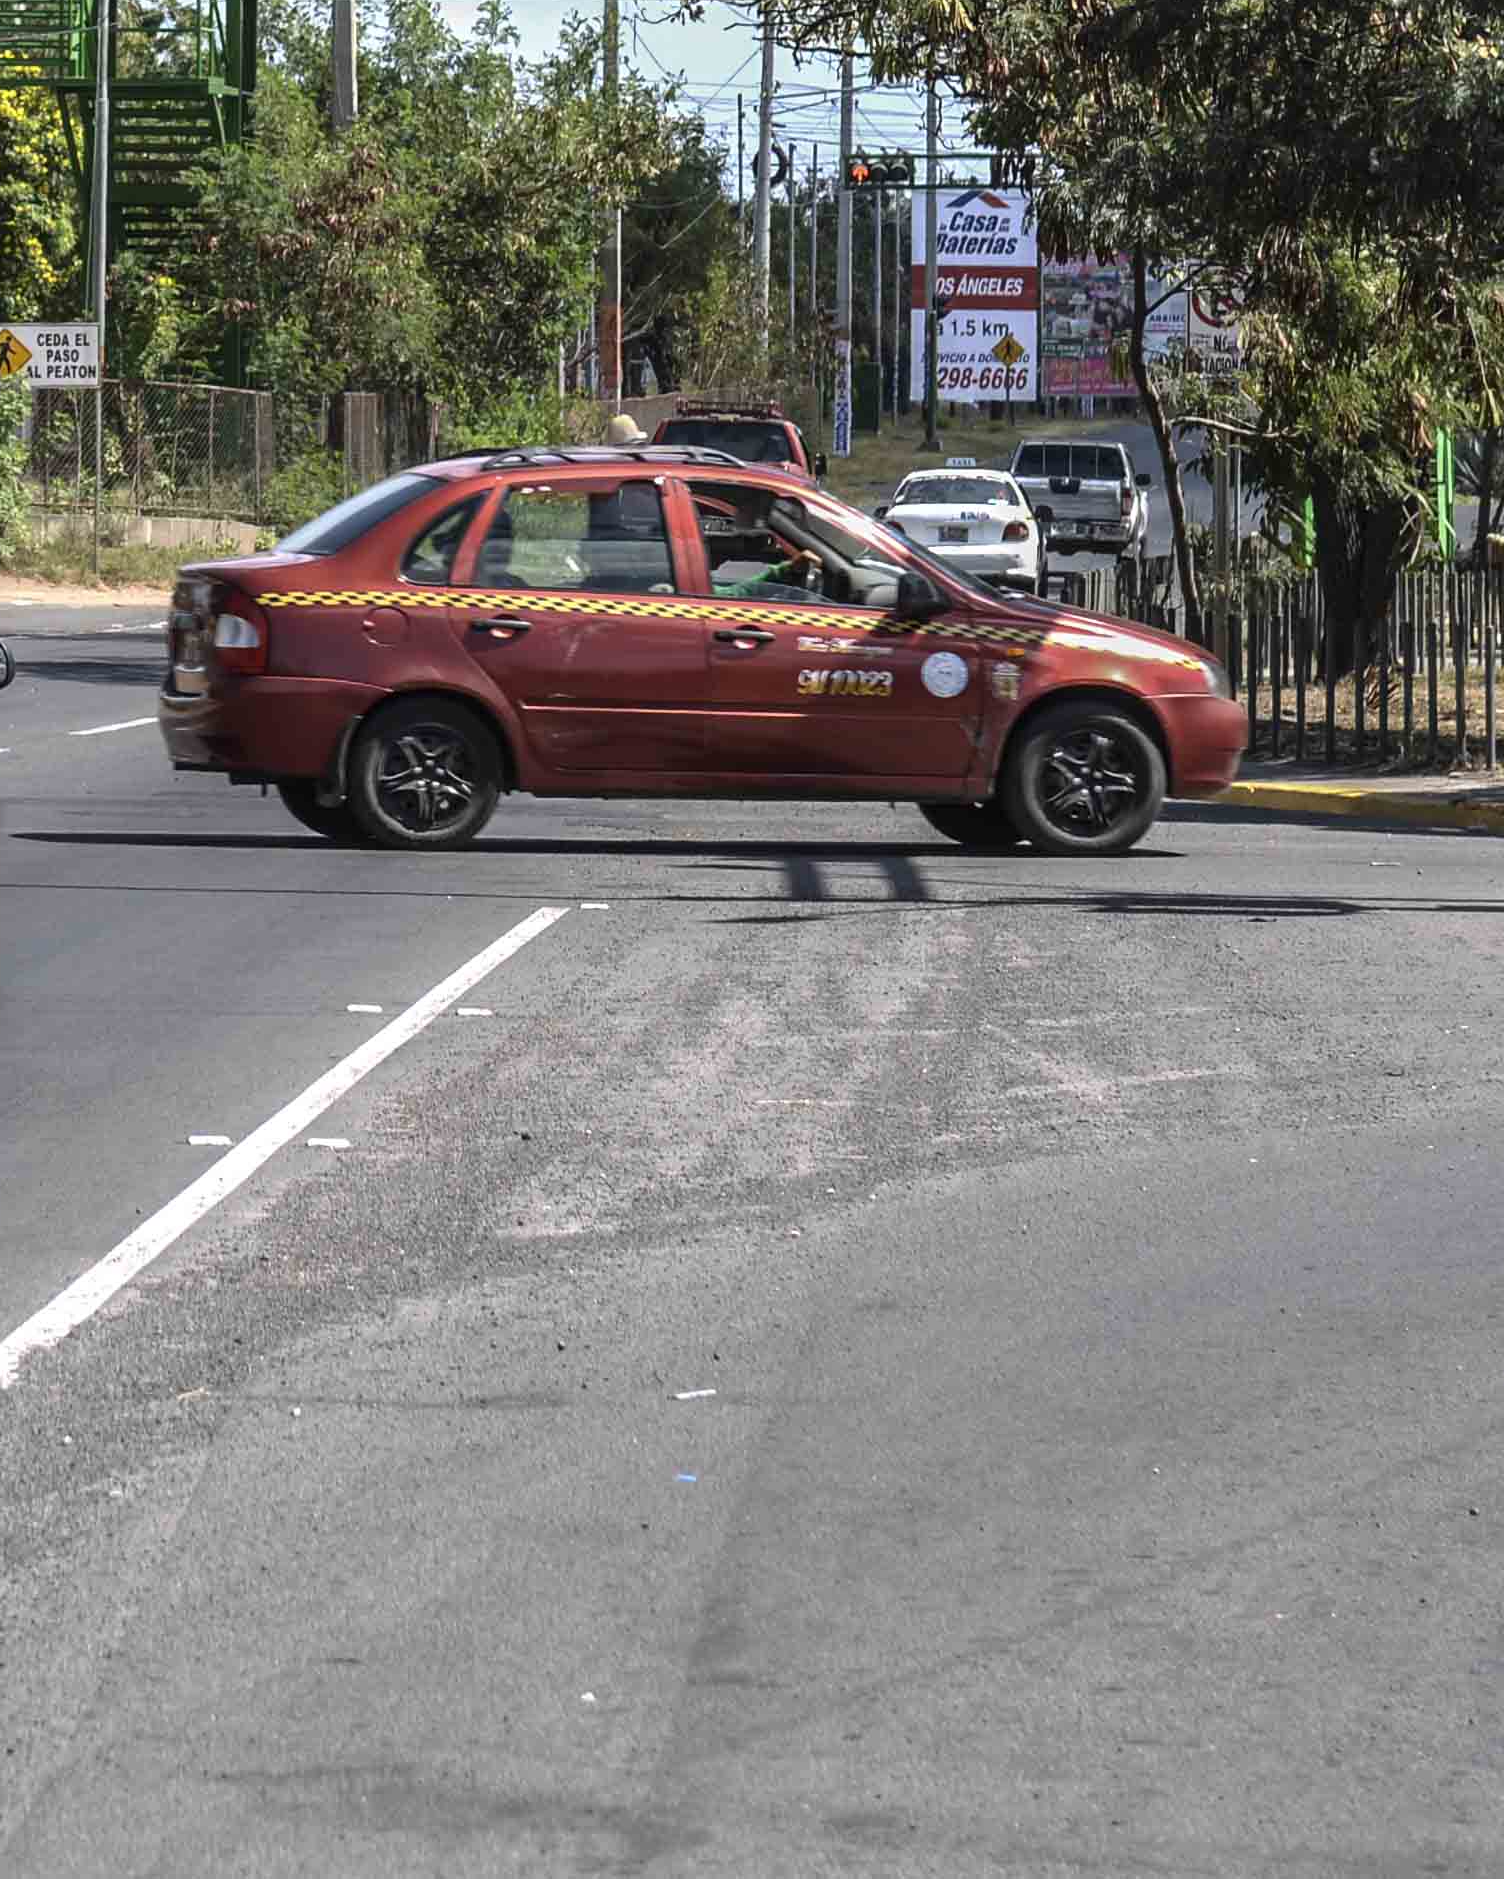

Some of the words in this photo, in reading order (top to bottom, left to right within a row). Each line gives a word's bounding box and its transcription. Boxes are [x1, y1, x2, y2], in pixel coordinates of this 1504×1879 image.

[949, 211, 999, 233] Casa
[956, 274, 1024, 296] ÁNGELES
[951, 319, 976, 337] 1.5
[37, 333, 69, 347] CEDA
[75, 333, 90, 347] EL
[47, 349, 80, 363] PASO
[27, 365, 41, 379] AL
[47, 365, 97, 379] PEATON
